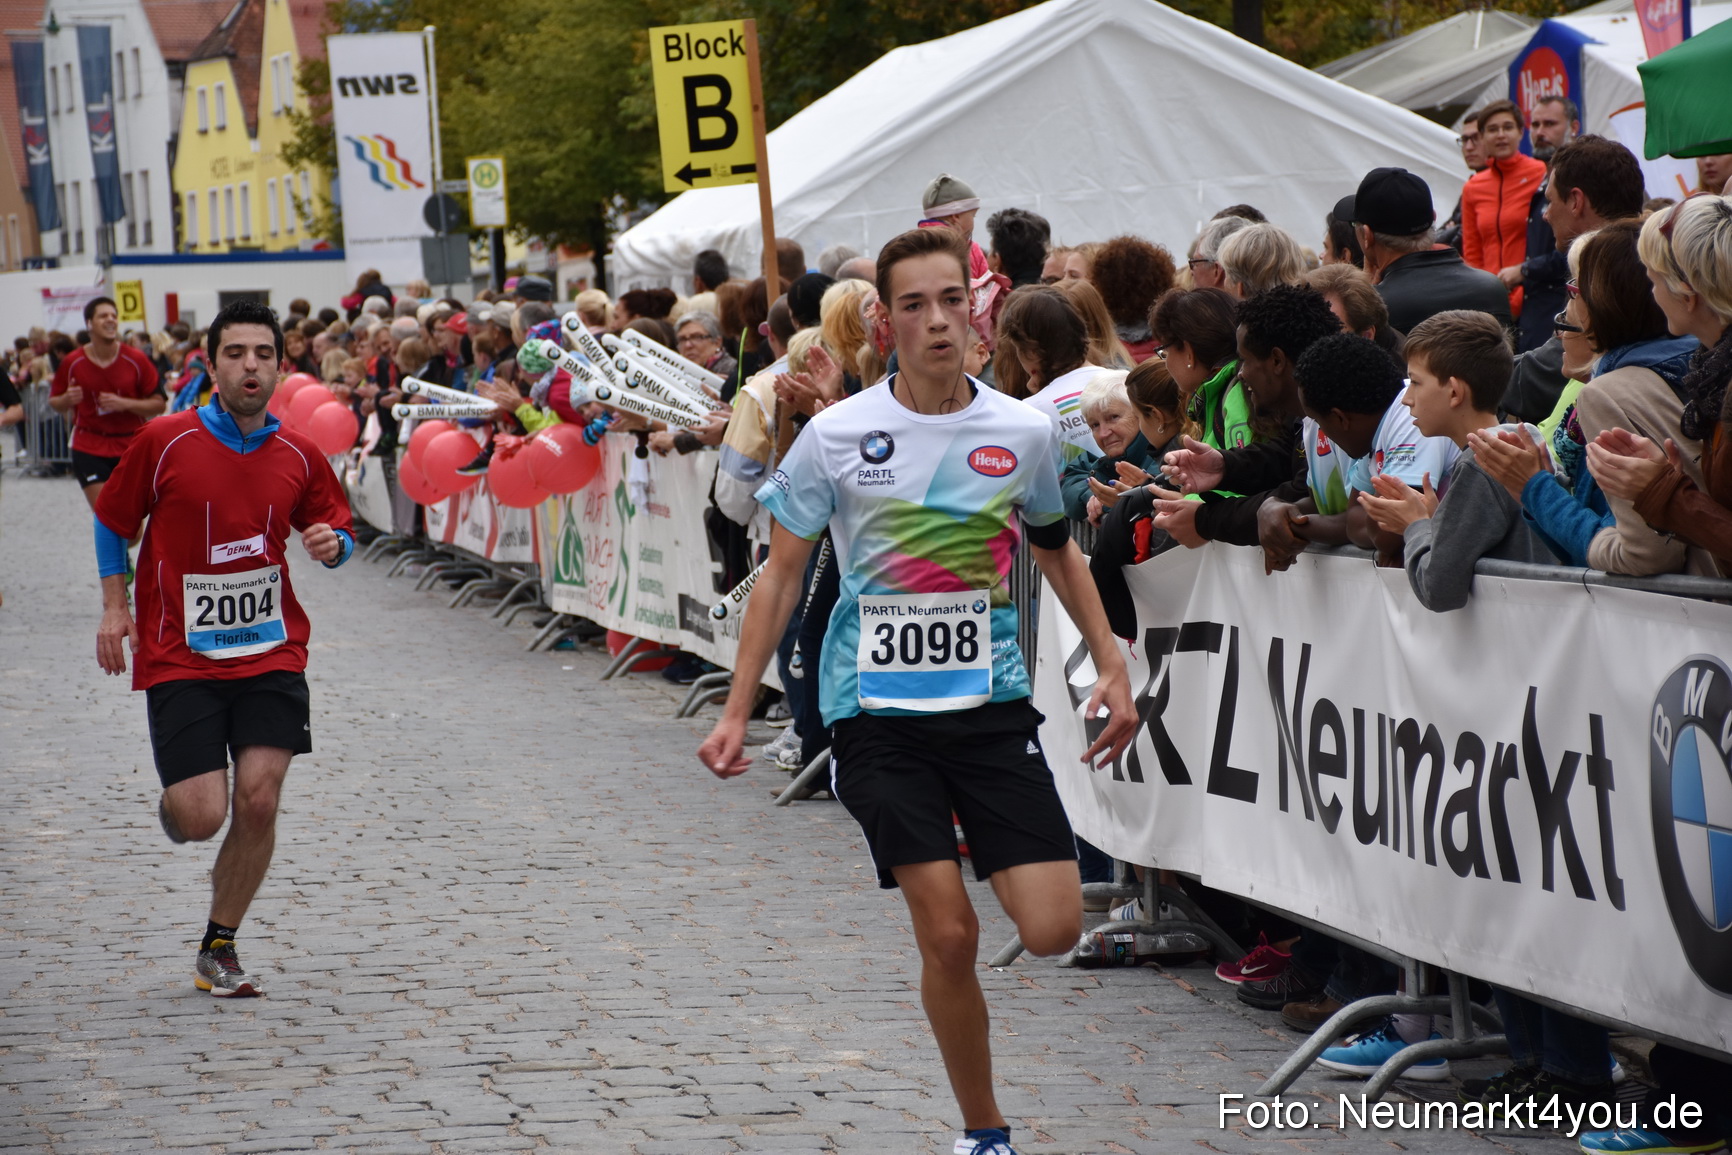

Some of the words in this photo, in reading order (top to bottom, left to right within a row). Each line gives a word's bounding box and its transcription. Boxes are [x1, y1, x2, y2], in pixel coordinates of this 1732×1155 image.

[664, 28, 746, 62] Block
[683, 73, 739, 153] B
[122, 293, 137, 313] D
[578, 334, 604, 364] BMW
[563, 358, 593, 383] BMW
[633, 369, 666, 398] BMW
[417, 406, 446, 417] BMW
[975, 452, 1013, 470] Hervis
[857, 478, 895, 487] Neumarkt
[858, 469, 895, 479] PARTL
[227, 543, 252, 556] DEHN
[186, 582, 220, 591] PARTL
[222, 576, 267, 591] Neumarkt
[196, 588, 273, 626] 2004
[863, 605, 906, 616] PARTL
[908, 603, 968, 616] Neumarkt
[214, 631, 260, 646] Florian
[871, 620, 979, 666] 3098
[1267, 636, 1626, 912] Neumarkt
